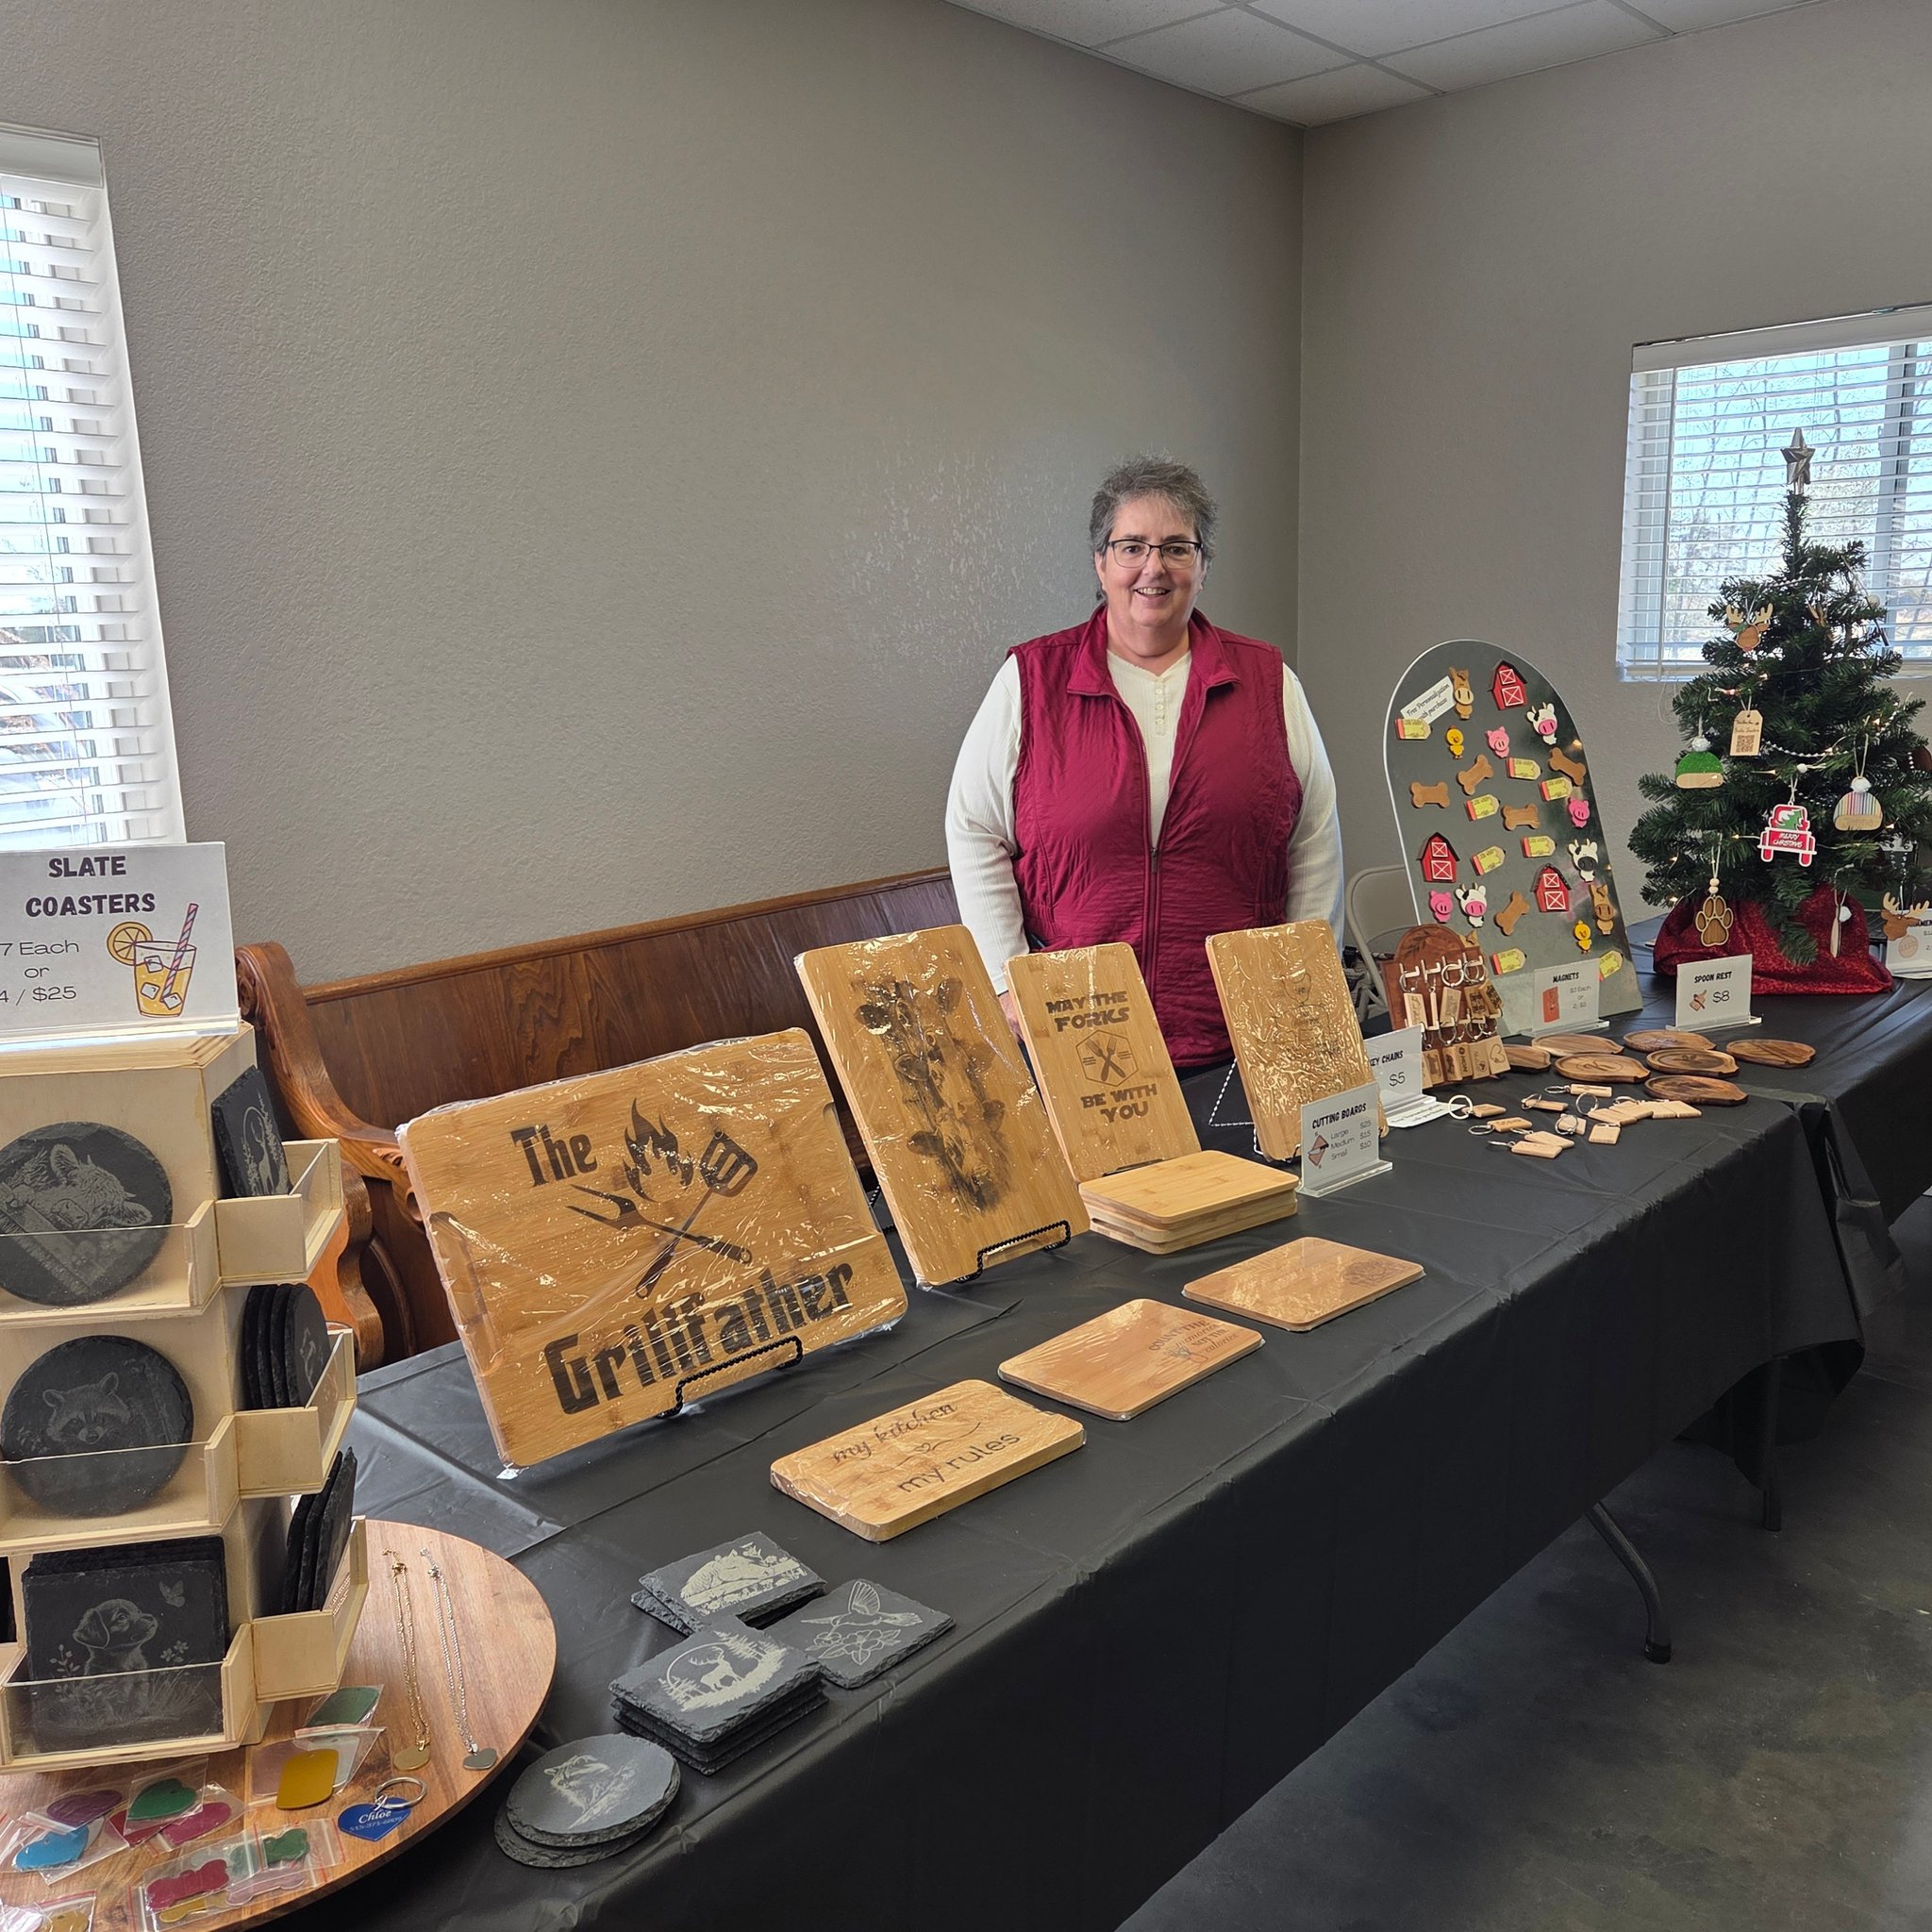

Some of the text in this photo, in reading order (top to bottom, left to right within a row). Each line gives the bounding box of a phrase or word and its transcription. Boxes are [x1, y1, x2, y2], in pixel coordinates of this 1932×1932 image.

[1774, 840, 1803, 848] CHRISTMAS
[1779, 832, 1800, 841] MERRY
[48, 856, 127, 878] SLATE
[25, 893, 156, 918] COASTERS
[20, 940, 79, 956] Each
[24, 966, 50, 978] or
[1553, 972, 1579, 983] MAGNETS
[1694, 972, 1732, 983] SPOON REST
[32, 986, 76, 1002] $25
[1045, 991, 1128, 1014] MAY THE
[1712, 990, 1730, 1003] $8
[1055, 1007, 1130, 1033] FORKS
[1382, 1050, 1404, 1063] CHAINS
[1389, 1071, 1406, 1086] $5
[1080, 1083, 1158, 1109] BE WITH
[1100, 1101, 1150, 1124] YOU
[1312, 1103, 1367, 1129] CUTTING BOARDS
[1330, 1129, 1349, 1141] Large
[1330, 1130, 1372, 1149] Medium $15
[510, 1124, 598, 1188] The
[1331, 1140, 1372, 1160] Small $10
[544, 1262, 854, 1415] Grillfather
[831, 1403, 958, 1463] my kitchen
[897, 1432, 1022, 1493] my rules
[358, 1809, 391, 1824] Chloe
